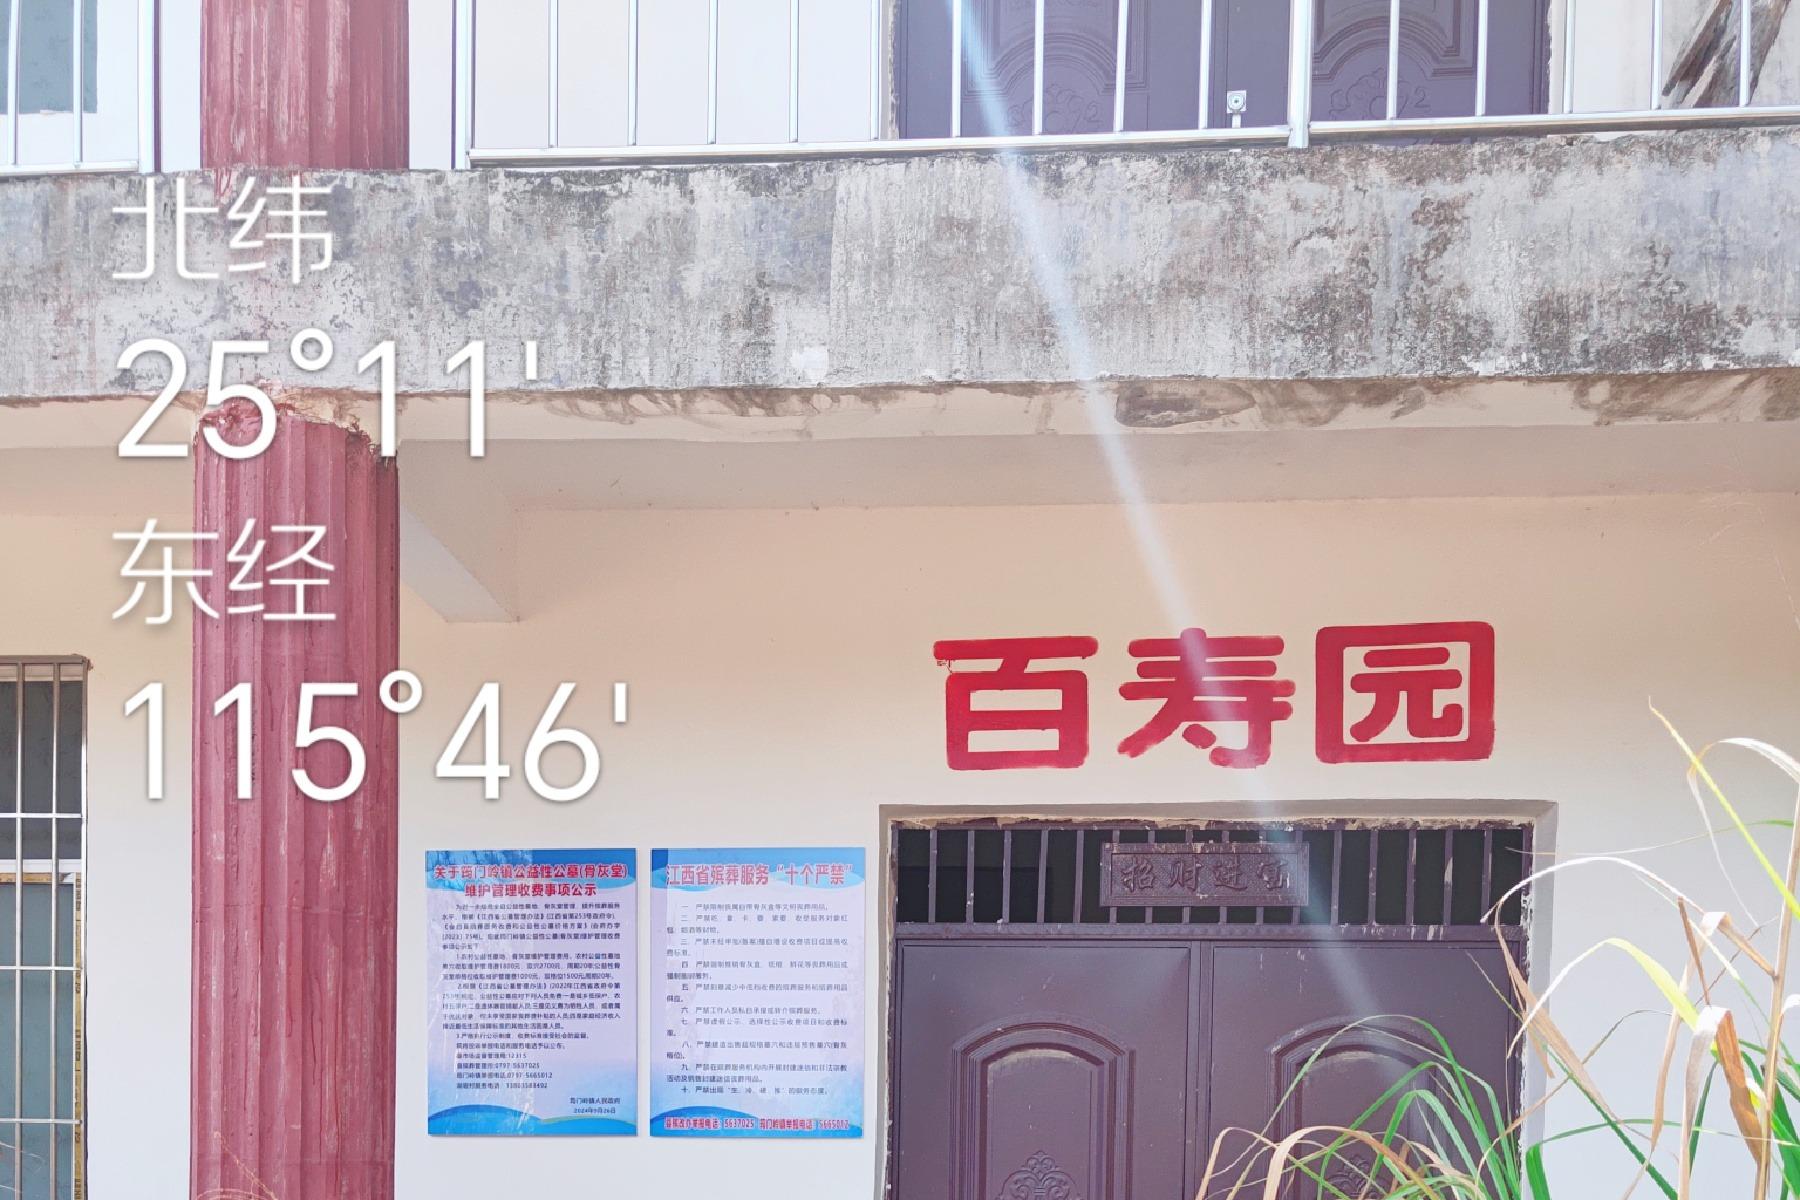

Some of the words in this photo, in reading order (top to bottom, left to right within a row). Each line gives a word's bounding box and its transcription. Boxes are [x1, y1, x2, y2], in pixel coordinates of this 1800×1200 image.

[932, 621, 1496, 770] 百寿园
[464, 883, 598, 897] 维护管理收费事项公示
